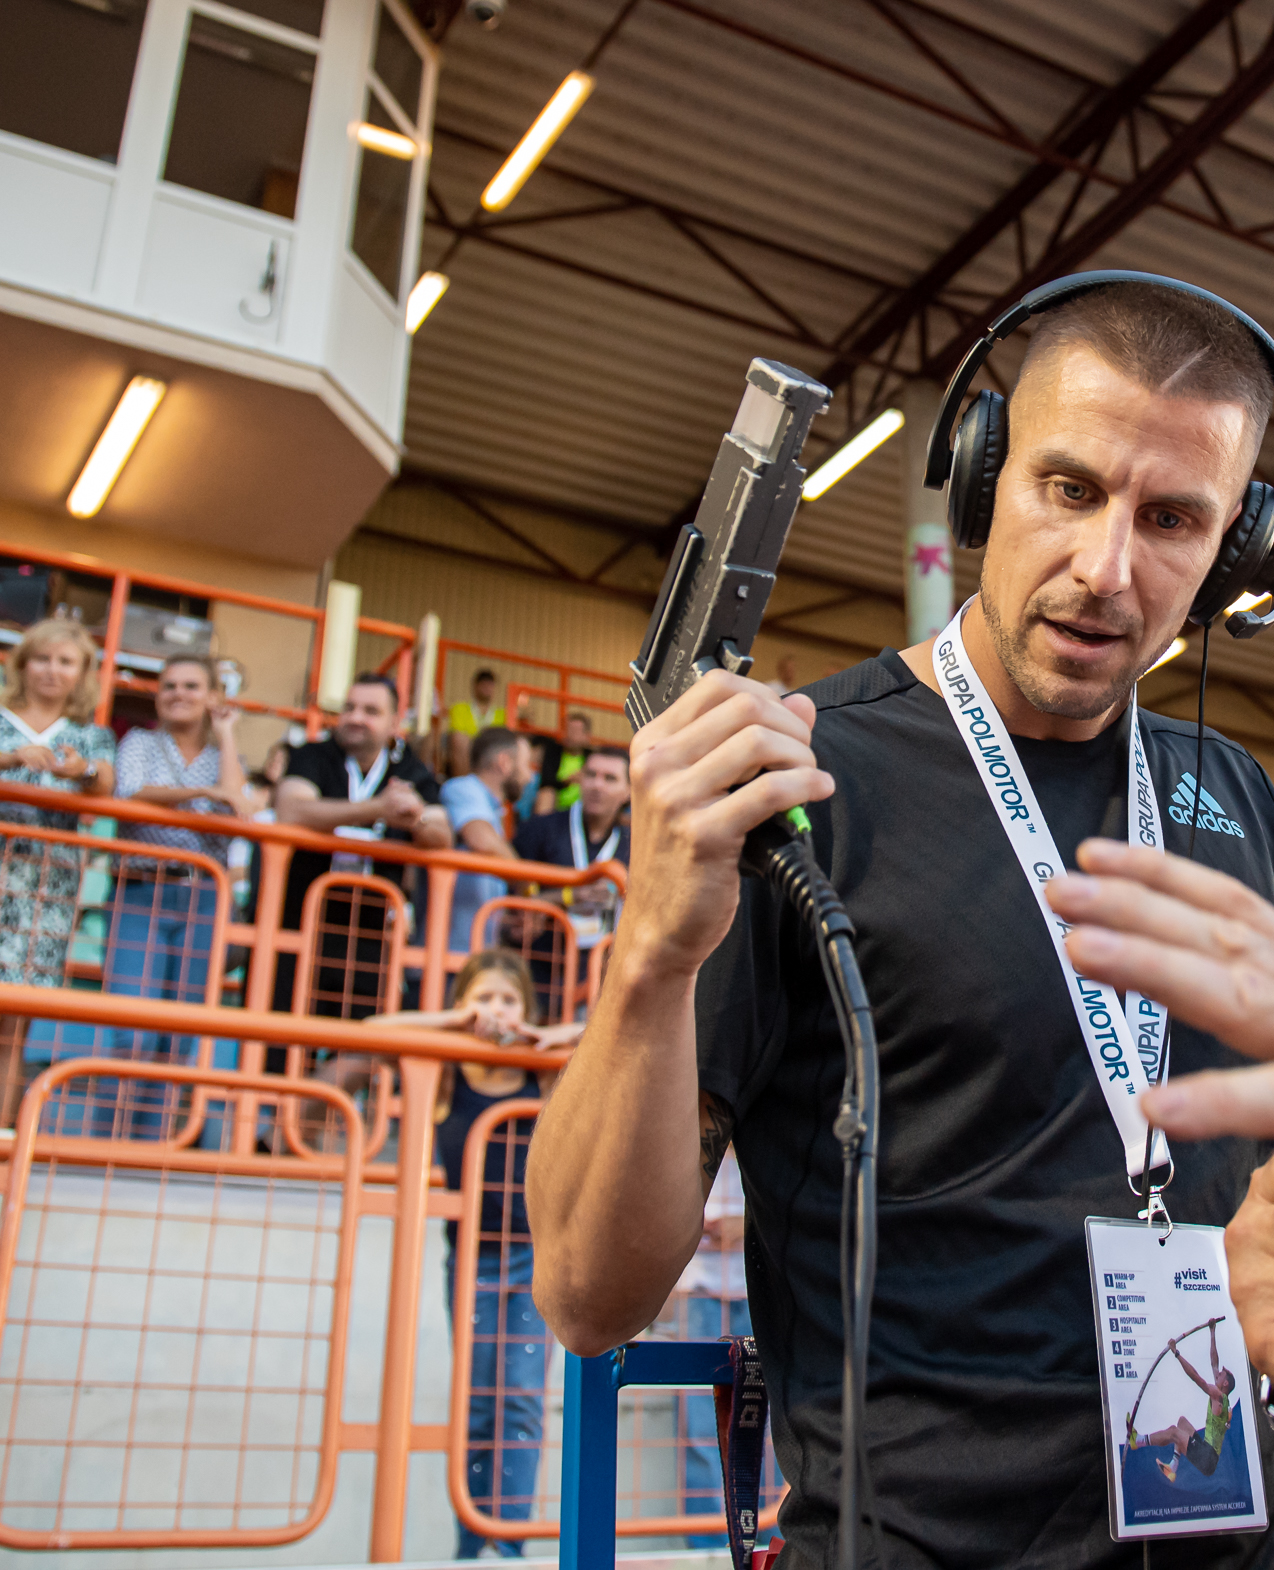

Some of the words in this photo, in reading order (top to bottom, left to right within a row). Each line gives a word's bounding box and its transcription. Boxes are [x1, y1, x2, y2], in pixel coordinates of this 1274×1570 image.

[938, 640, 975, 709] GRUPA
[961, 706, 1030, 821] POLMOTOR
[1137, 779, 1157, 848] GRUPA
[1168, 805, 1245, 839] adidas
[1138, 1021, 1159, 1087] RUPA
[1114, 1272, 1135, 1281] WARM-UP
[1115, 1281, 1127, 1290] AREA
[1116, 1295, 1146, 1303] COMPETITION
[1119, 1317, 1147, 1325] HOSPITALITY
[1121, 1326, 1133, 1334] AREA
[1122, 1339, 1137, 1347] MEDIA
[1123, 1348, 1135, 1356] ZONE
[1126, 1371, 1138, 1379] AREA
